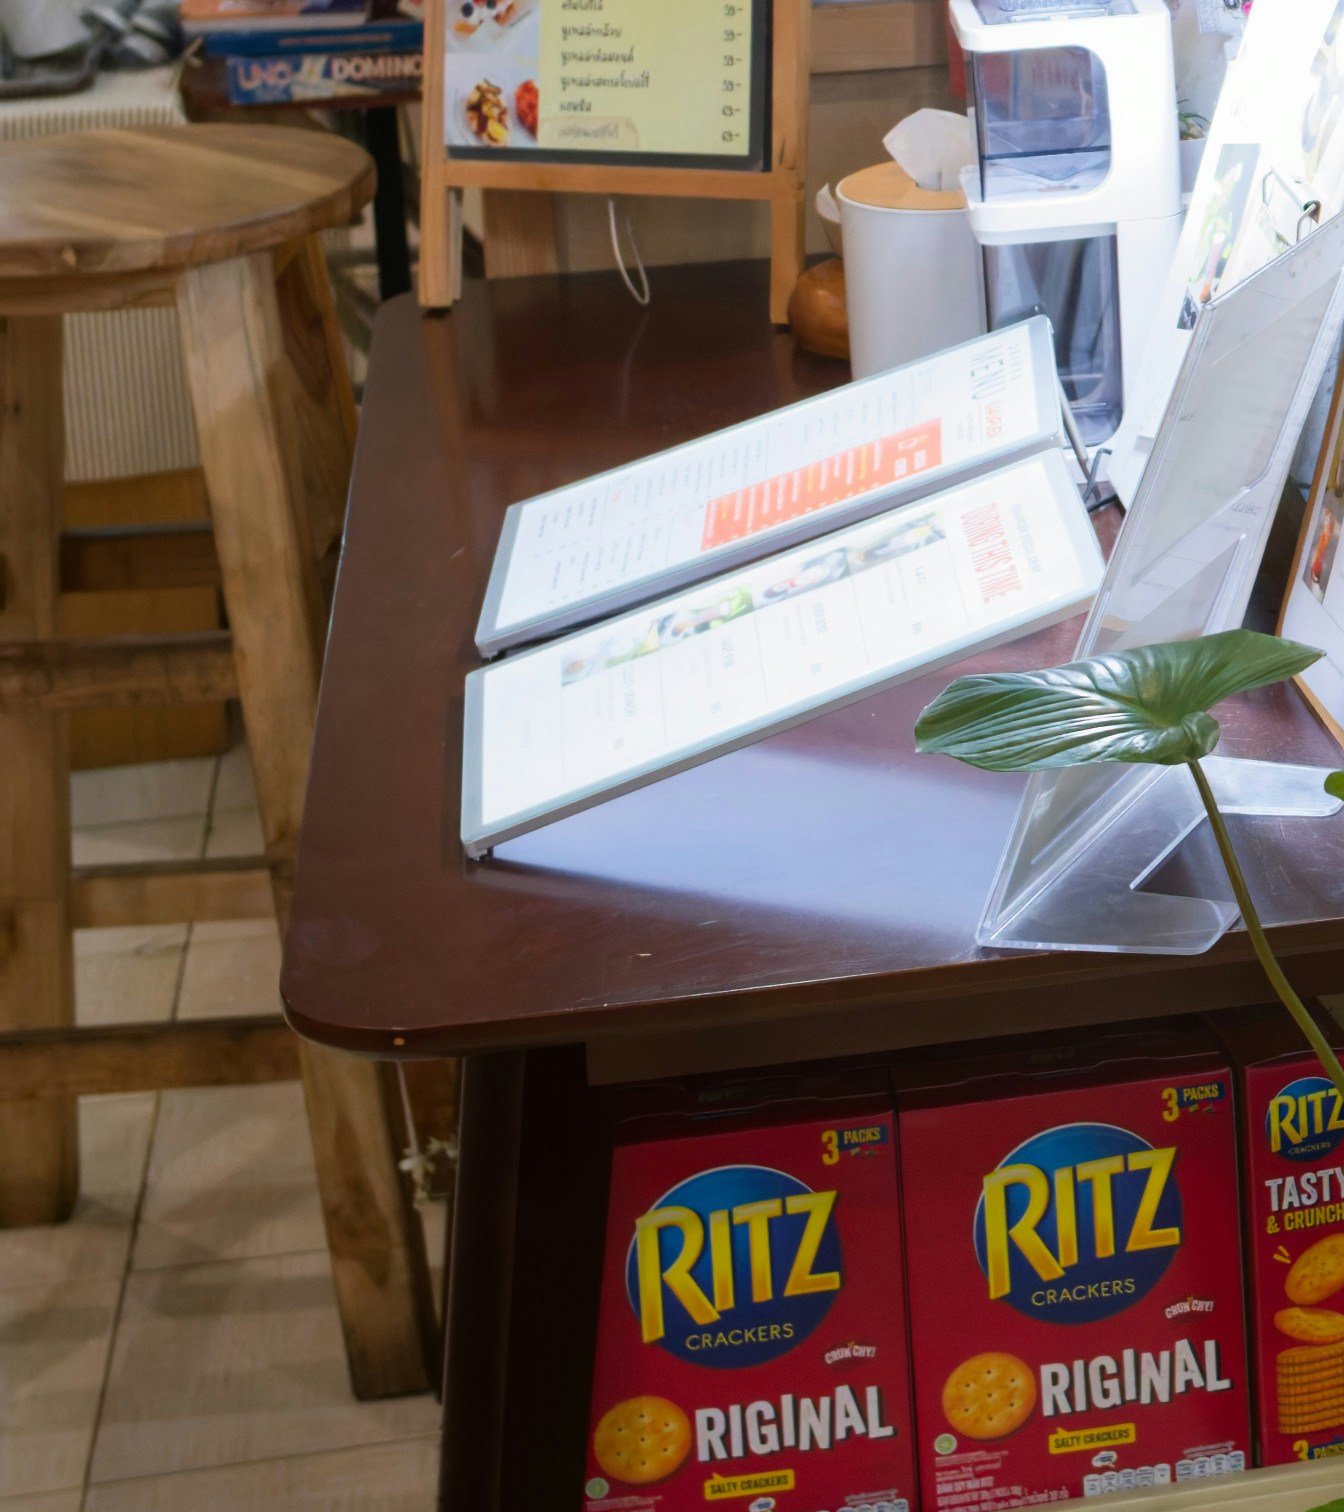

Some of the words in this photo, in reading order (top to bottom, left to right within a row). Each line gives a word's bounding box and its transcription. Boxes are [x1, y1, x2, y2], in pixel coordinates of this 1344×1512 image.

[970, 345, 1007, 400] MENU
[960, 502, 1006, 548] DURING
[970, 538, 1014, 573] THIS
[977, 564, 1022, 604] TIME
[1161, 1087, 1181, 1123] 3
[1183, 1083, 1220, 1103] PACKS
[822, 1129, 840, 1166] 3
[843, 1126, 881, 1146] PACKS
[1287, 1140, 1332, 1157] CRACKERS
[983, 1147, 1181, 1301] RITZ
[1266, 1215, 1281, 1235] &
[635, 1189, 841, 1344] RITZ
[1031, 1277, 1137, 1307] CRACKERS
[1164, 1297, 1215, 1320] CRUNCHY!
[685, 1323, 796, 1351] CRACKERS
[824, 1342, 876, 1366] CRUNCHY!
[1053, 1434, 1082, 1450] SALTY
[1083, 1428, 1131, 1447] CRACKERS
[709, 1478, 739, 1496] SALTY
[740, 1473, 790, 1491] CRACKERS
